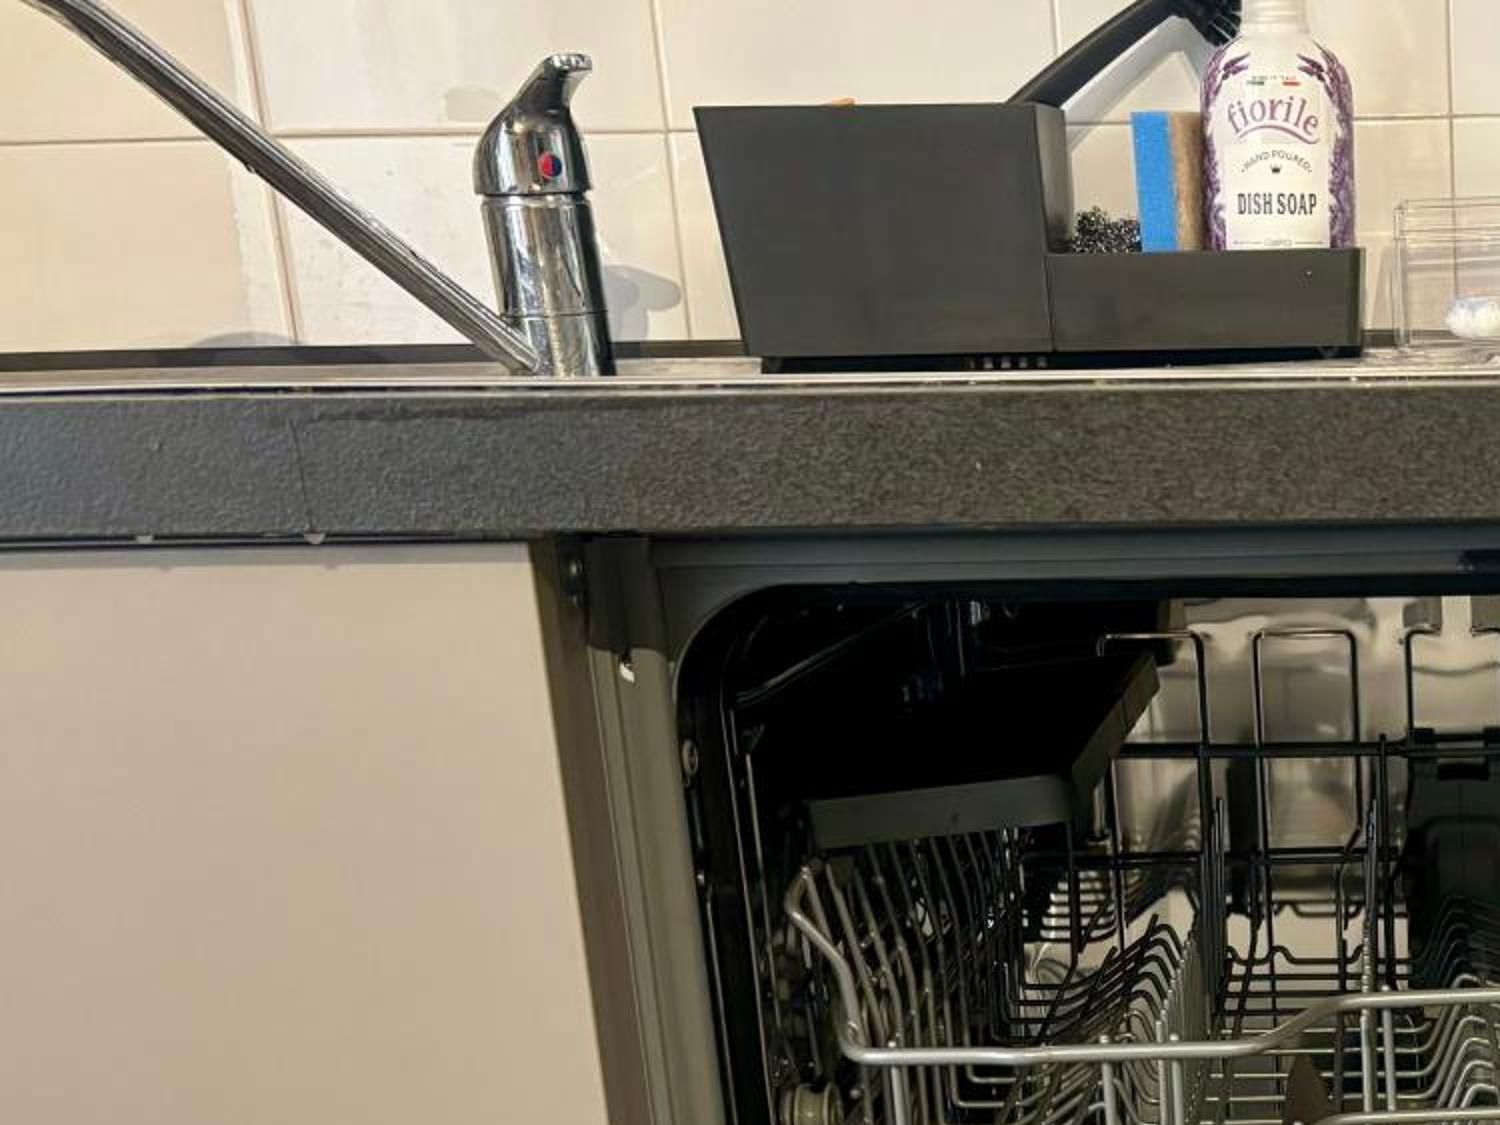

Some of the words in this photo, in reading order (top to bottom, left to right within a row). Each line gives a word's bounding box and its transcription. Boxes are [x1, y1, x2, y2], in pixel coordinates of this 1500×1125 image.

[1228, 96, 1318, 134] fiorile
[1238, 193, 1273, 214] DISH
[1277, 193, 1317, 215] SOAP
